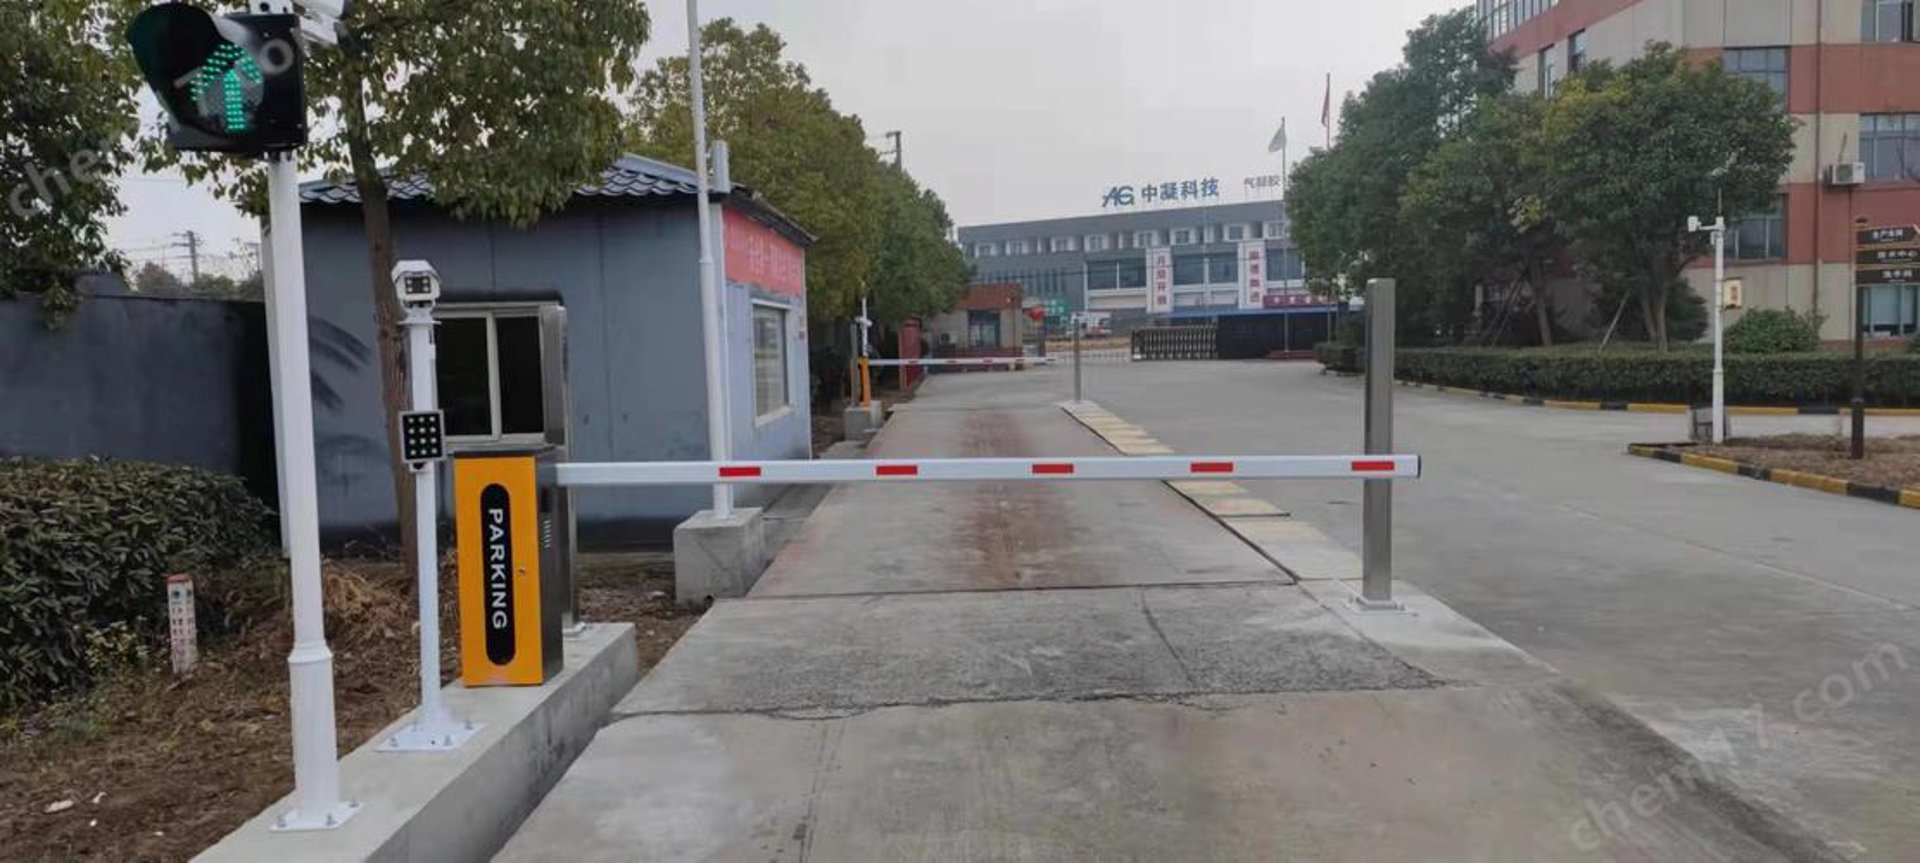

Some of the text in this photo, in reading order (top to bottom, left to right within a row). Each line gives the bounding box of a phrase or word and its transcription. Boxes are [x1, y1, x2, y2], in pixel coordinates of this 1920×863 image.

[1140, 177, 1220, 203] 中凝科技
[488, 508, 508, 630] PARKING
